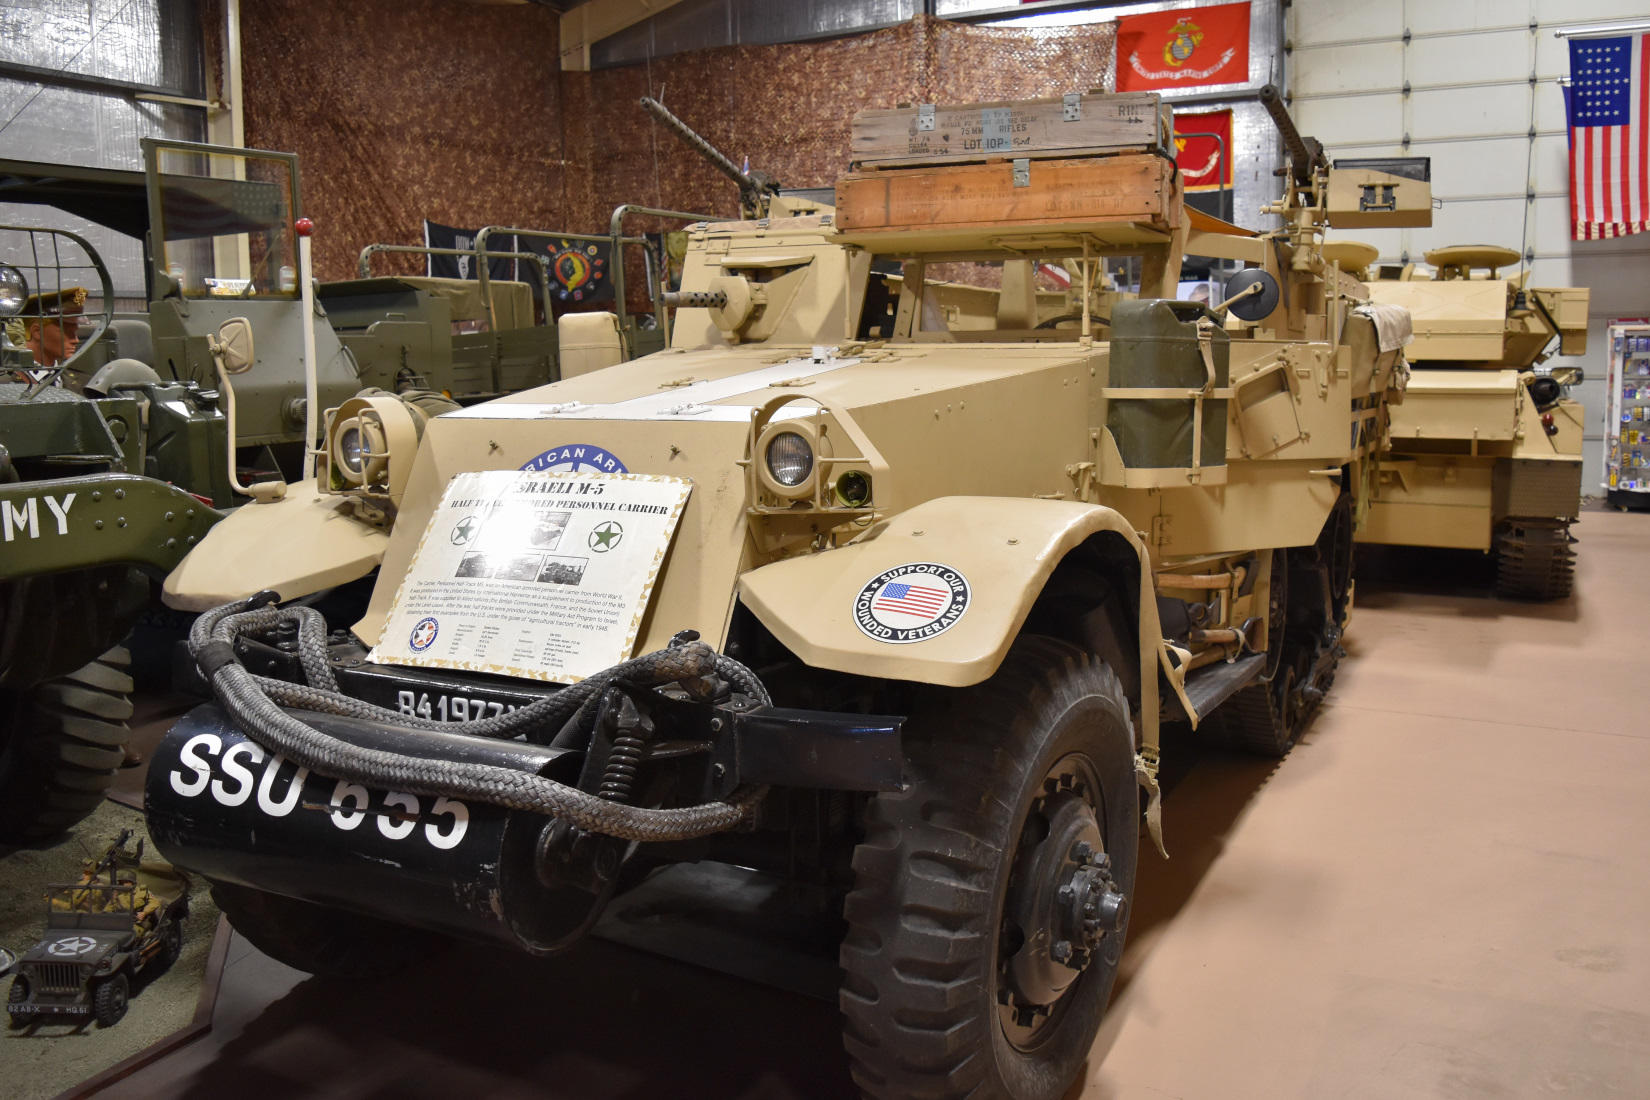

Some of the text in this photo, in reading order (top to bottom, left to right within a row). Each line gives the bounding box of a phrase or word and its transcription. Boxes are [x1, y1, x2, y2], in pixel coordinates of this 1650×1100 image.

[961, 127, 970, 135] 75
[999, 123, 1027, 132] RIFLES
[964, 138, 983, 150] LOT
[524, 448, 585, 472] RICAN
[515, 481, 606, 495] SRAELI M-5
[556, 500, 616, 511] PERSONNEL
[618, 503, 668, 515] CARRIER
[880, 565, 965, 593] SUPPORT OUR
[858, 591, 964, 640] WOUNDED VETERANS
[170, 733, 309, 816] SSU
